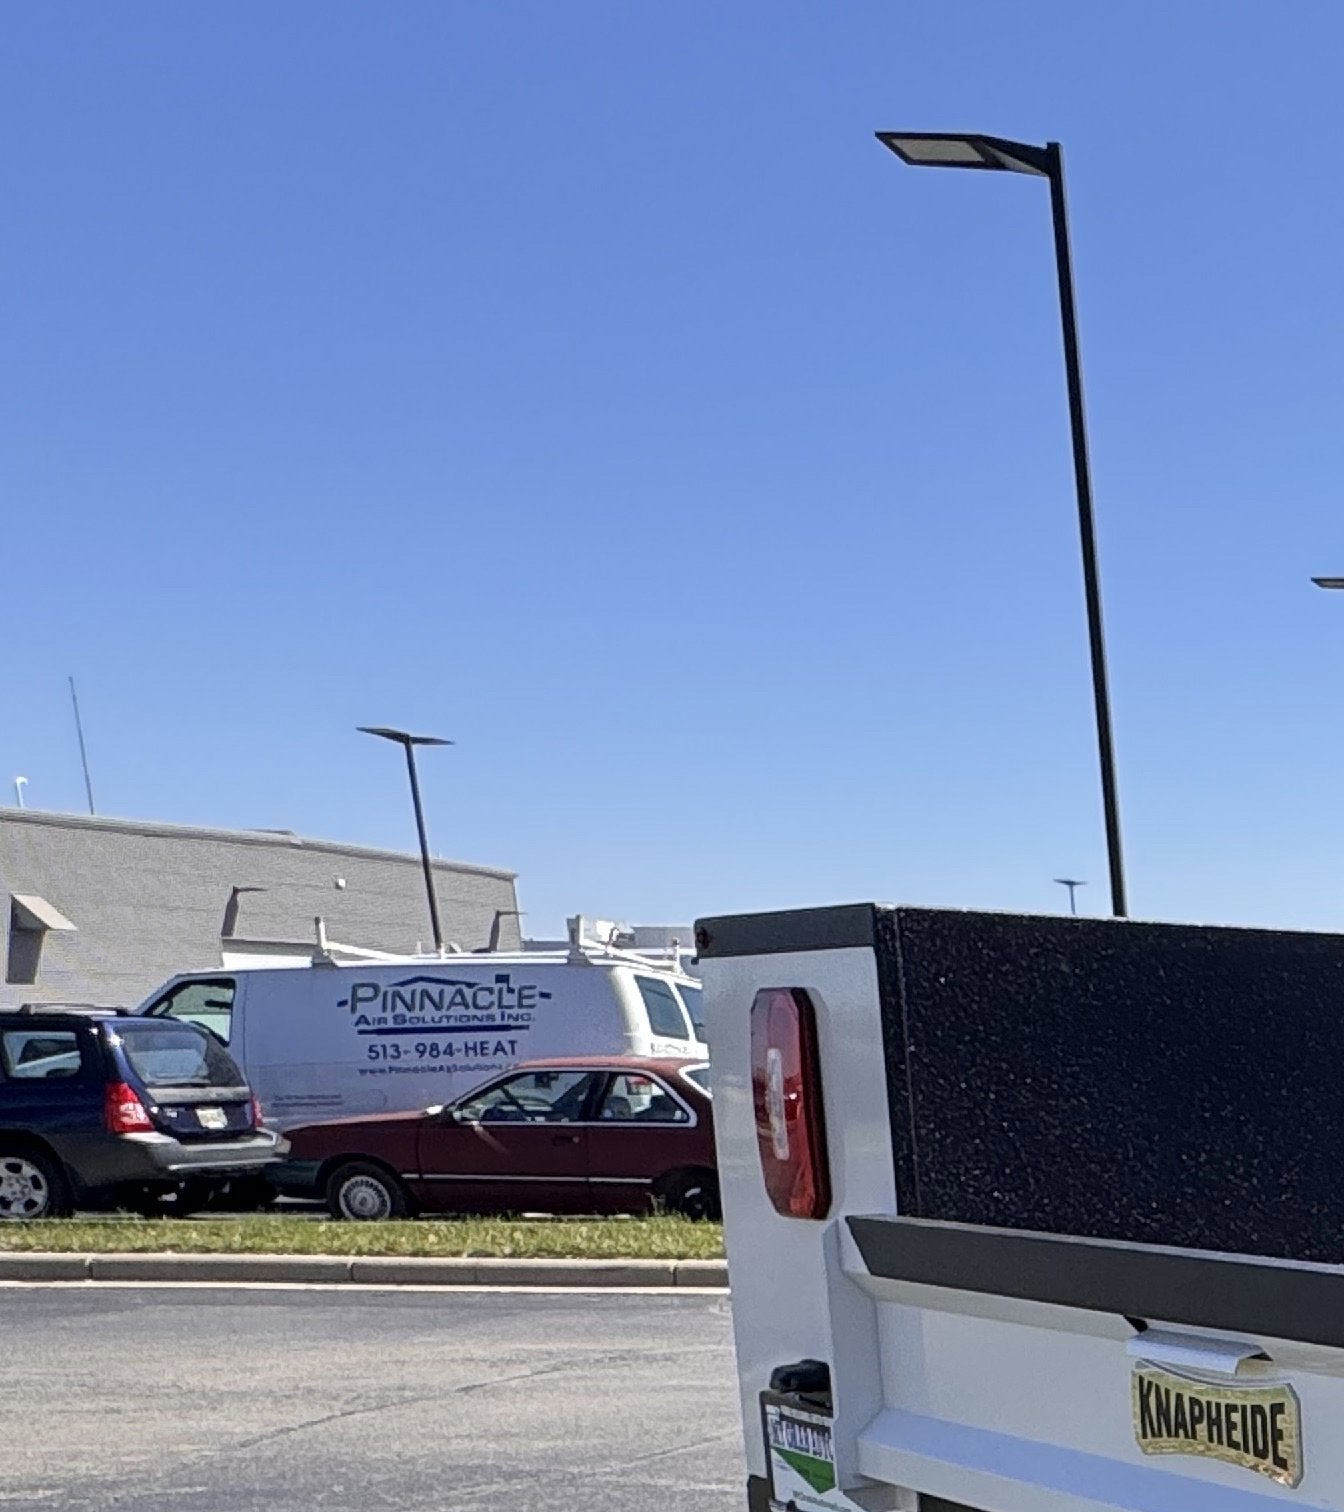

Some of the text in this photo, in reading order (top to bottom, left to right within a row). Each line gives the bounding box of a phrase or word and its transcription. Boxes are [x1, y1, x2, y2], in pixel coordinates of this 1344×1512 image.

[350, 982, 538, 1015] PINNACLE
[354, 1014, 388, 1027] AIR
[392, 1013, 496, 1026] SOLUTIONS
[1138, 1374, 1289, 1472] KNAPHEIDE
